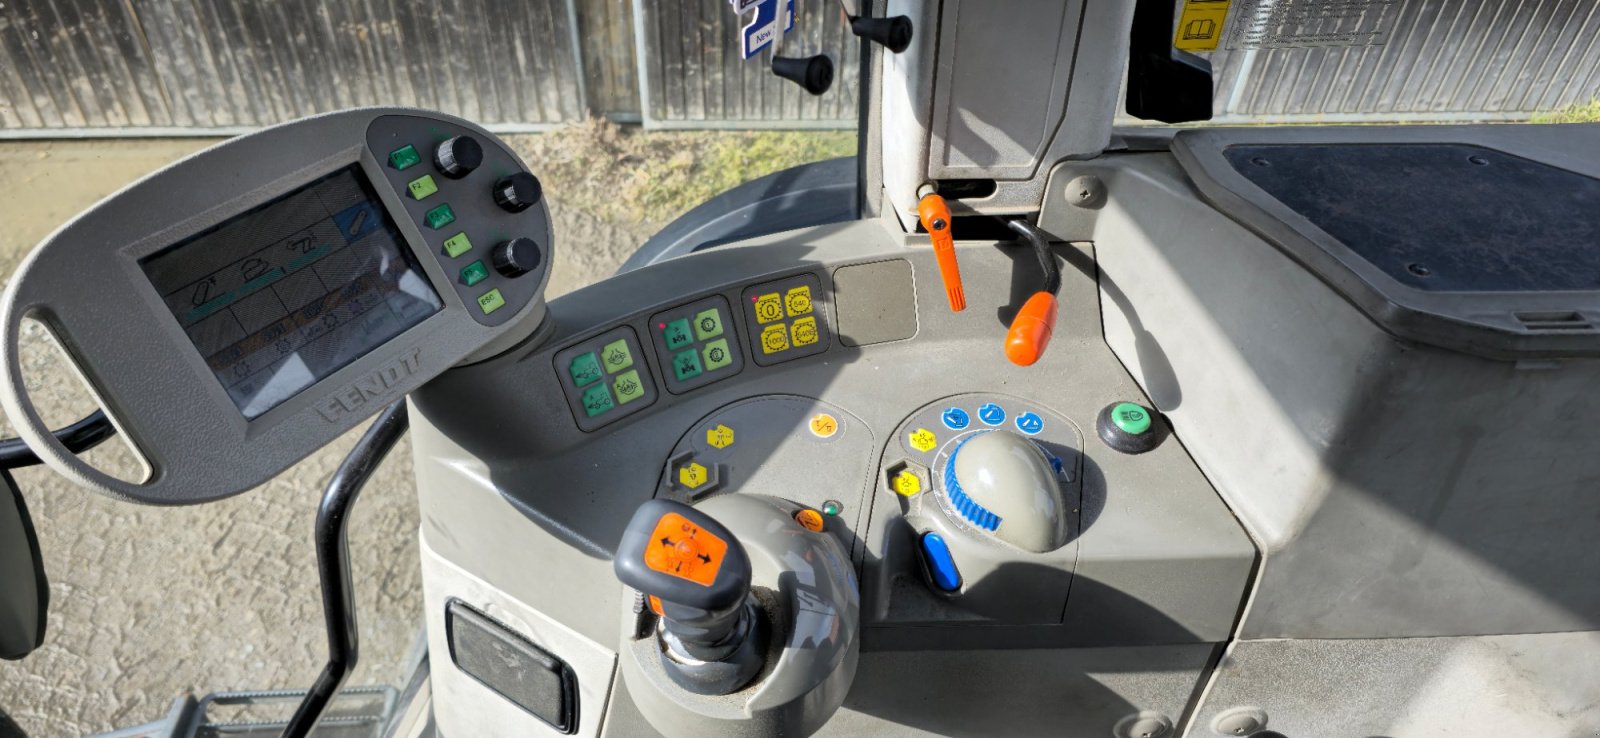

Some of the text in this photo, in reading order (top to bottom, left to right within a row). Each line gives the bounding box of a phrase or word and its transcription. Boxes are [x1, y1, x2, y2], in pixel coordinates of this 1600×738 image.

[756, 30, 772, 45] New
[411, 182, 422, 190] F2
[446, 240, 457, 249] F4
[480, 294, 496, 306] ESC
[314, 347, 421, 424] FENDT
